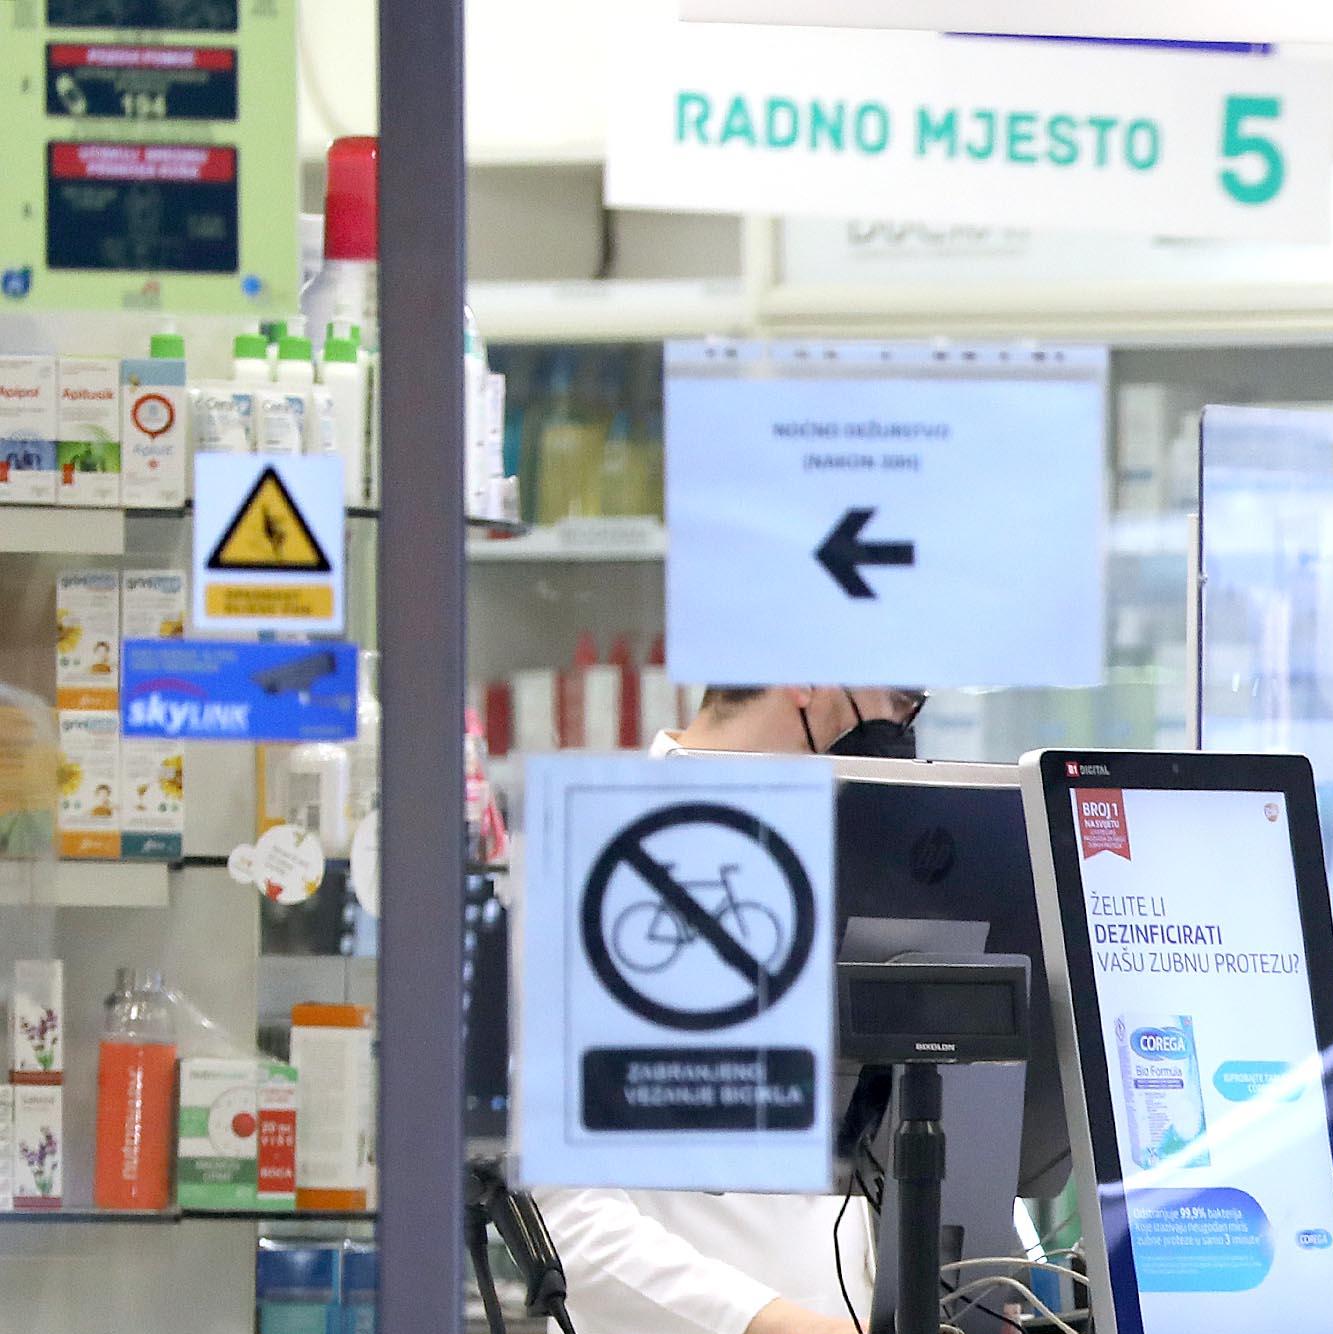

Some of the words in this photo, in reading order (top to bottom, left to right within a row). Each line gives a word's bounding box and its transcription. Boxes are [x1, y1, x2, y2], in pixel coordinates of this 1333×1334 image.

[673, 90, 891, 156] RADNO
[915, 106, 1162, 172] MJESTO
[1219, 93, 1287, 206] 5
[1082, 802, 1111, 820] BROJ
[1112, 802, 1119, 817] 1
[1090, 890, 1150, 917] ŽELITE
[1151, 896, 1167, 917] LI
[1094, 923, 1224, 946] DEZINFICIRATI
[1098, 947, 1145, 973] VAŠU
[1149, 951, 1210, 974] ZUBNU
[1215, 952, 1300, 975] PROTEZU?
[1139, 1035, 1186, 1052] COREGA
